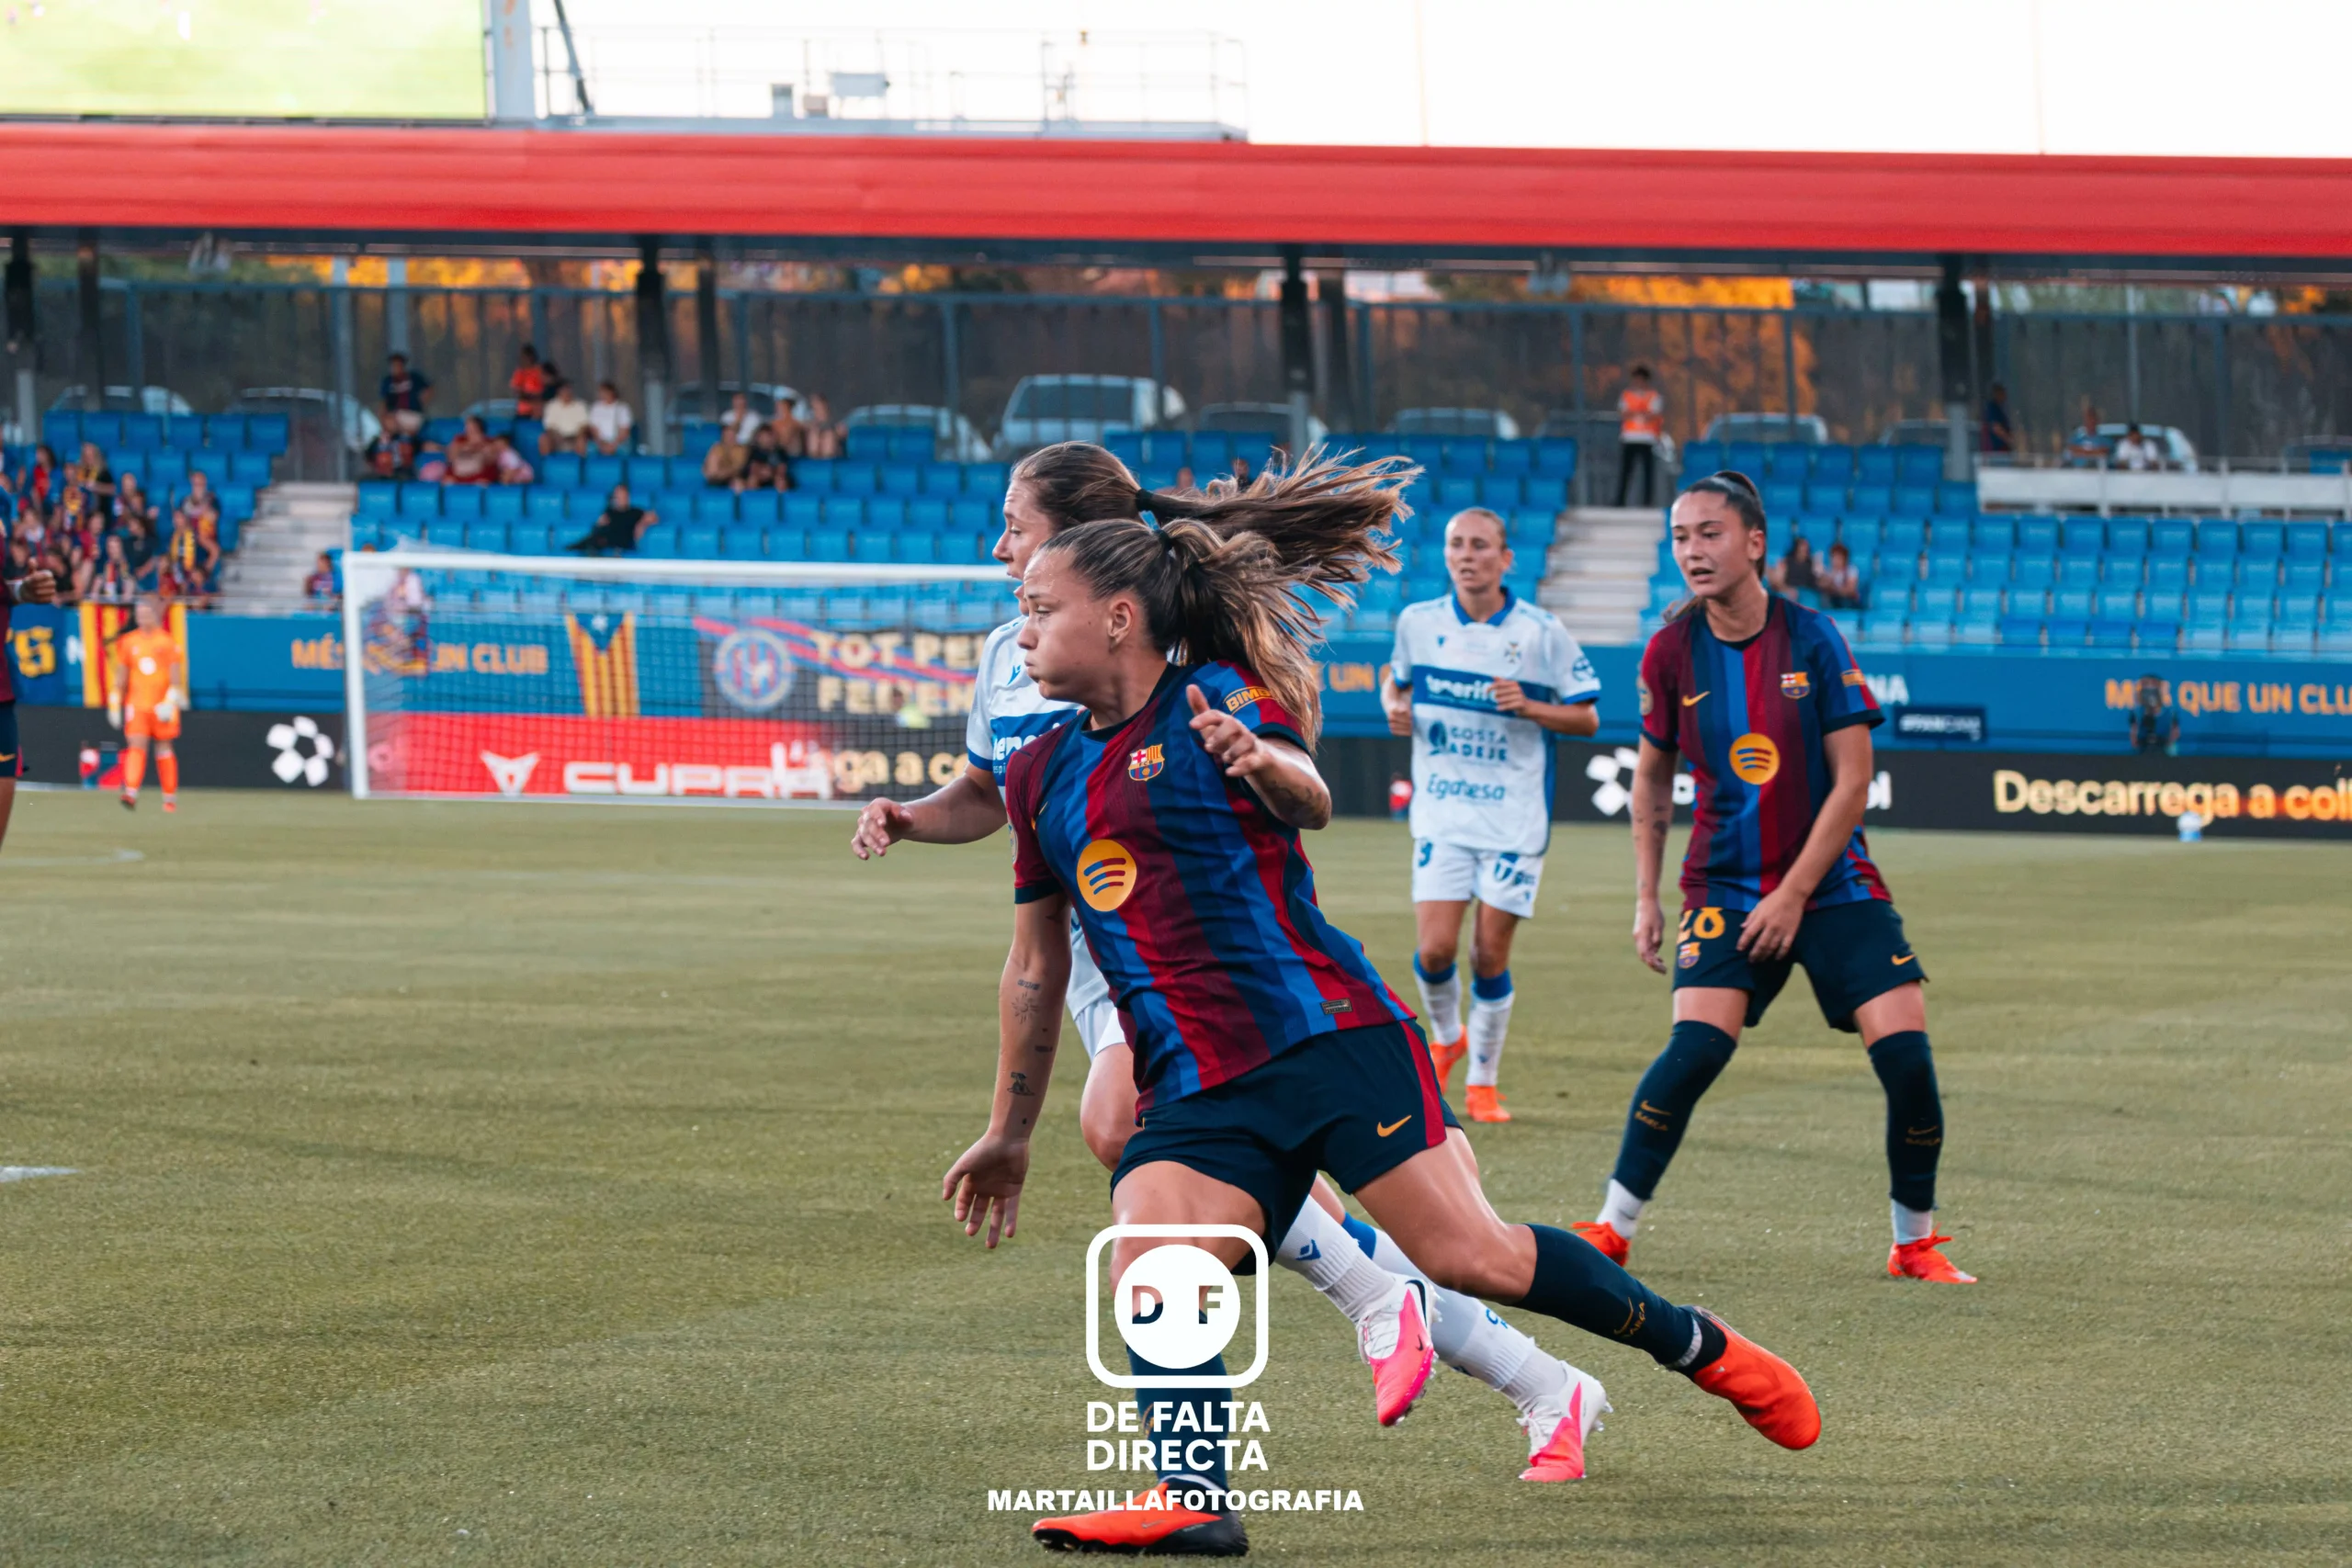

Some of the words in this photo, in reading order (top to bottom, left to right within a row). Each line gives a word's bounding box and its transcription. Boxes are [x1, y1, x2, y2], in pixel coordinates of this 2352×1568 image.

[471, 643, 549, 674] CLUB
[2178, 681, 2242, 717] QUE
[2247, 682, 2293, 714] UN
[1992, 769, 2240, 828] Descarrega
[2247, 784, 2278, 819] a
